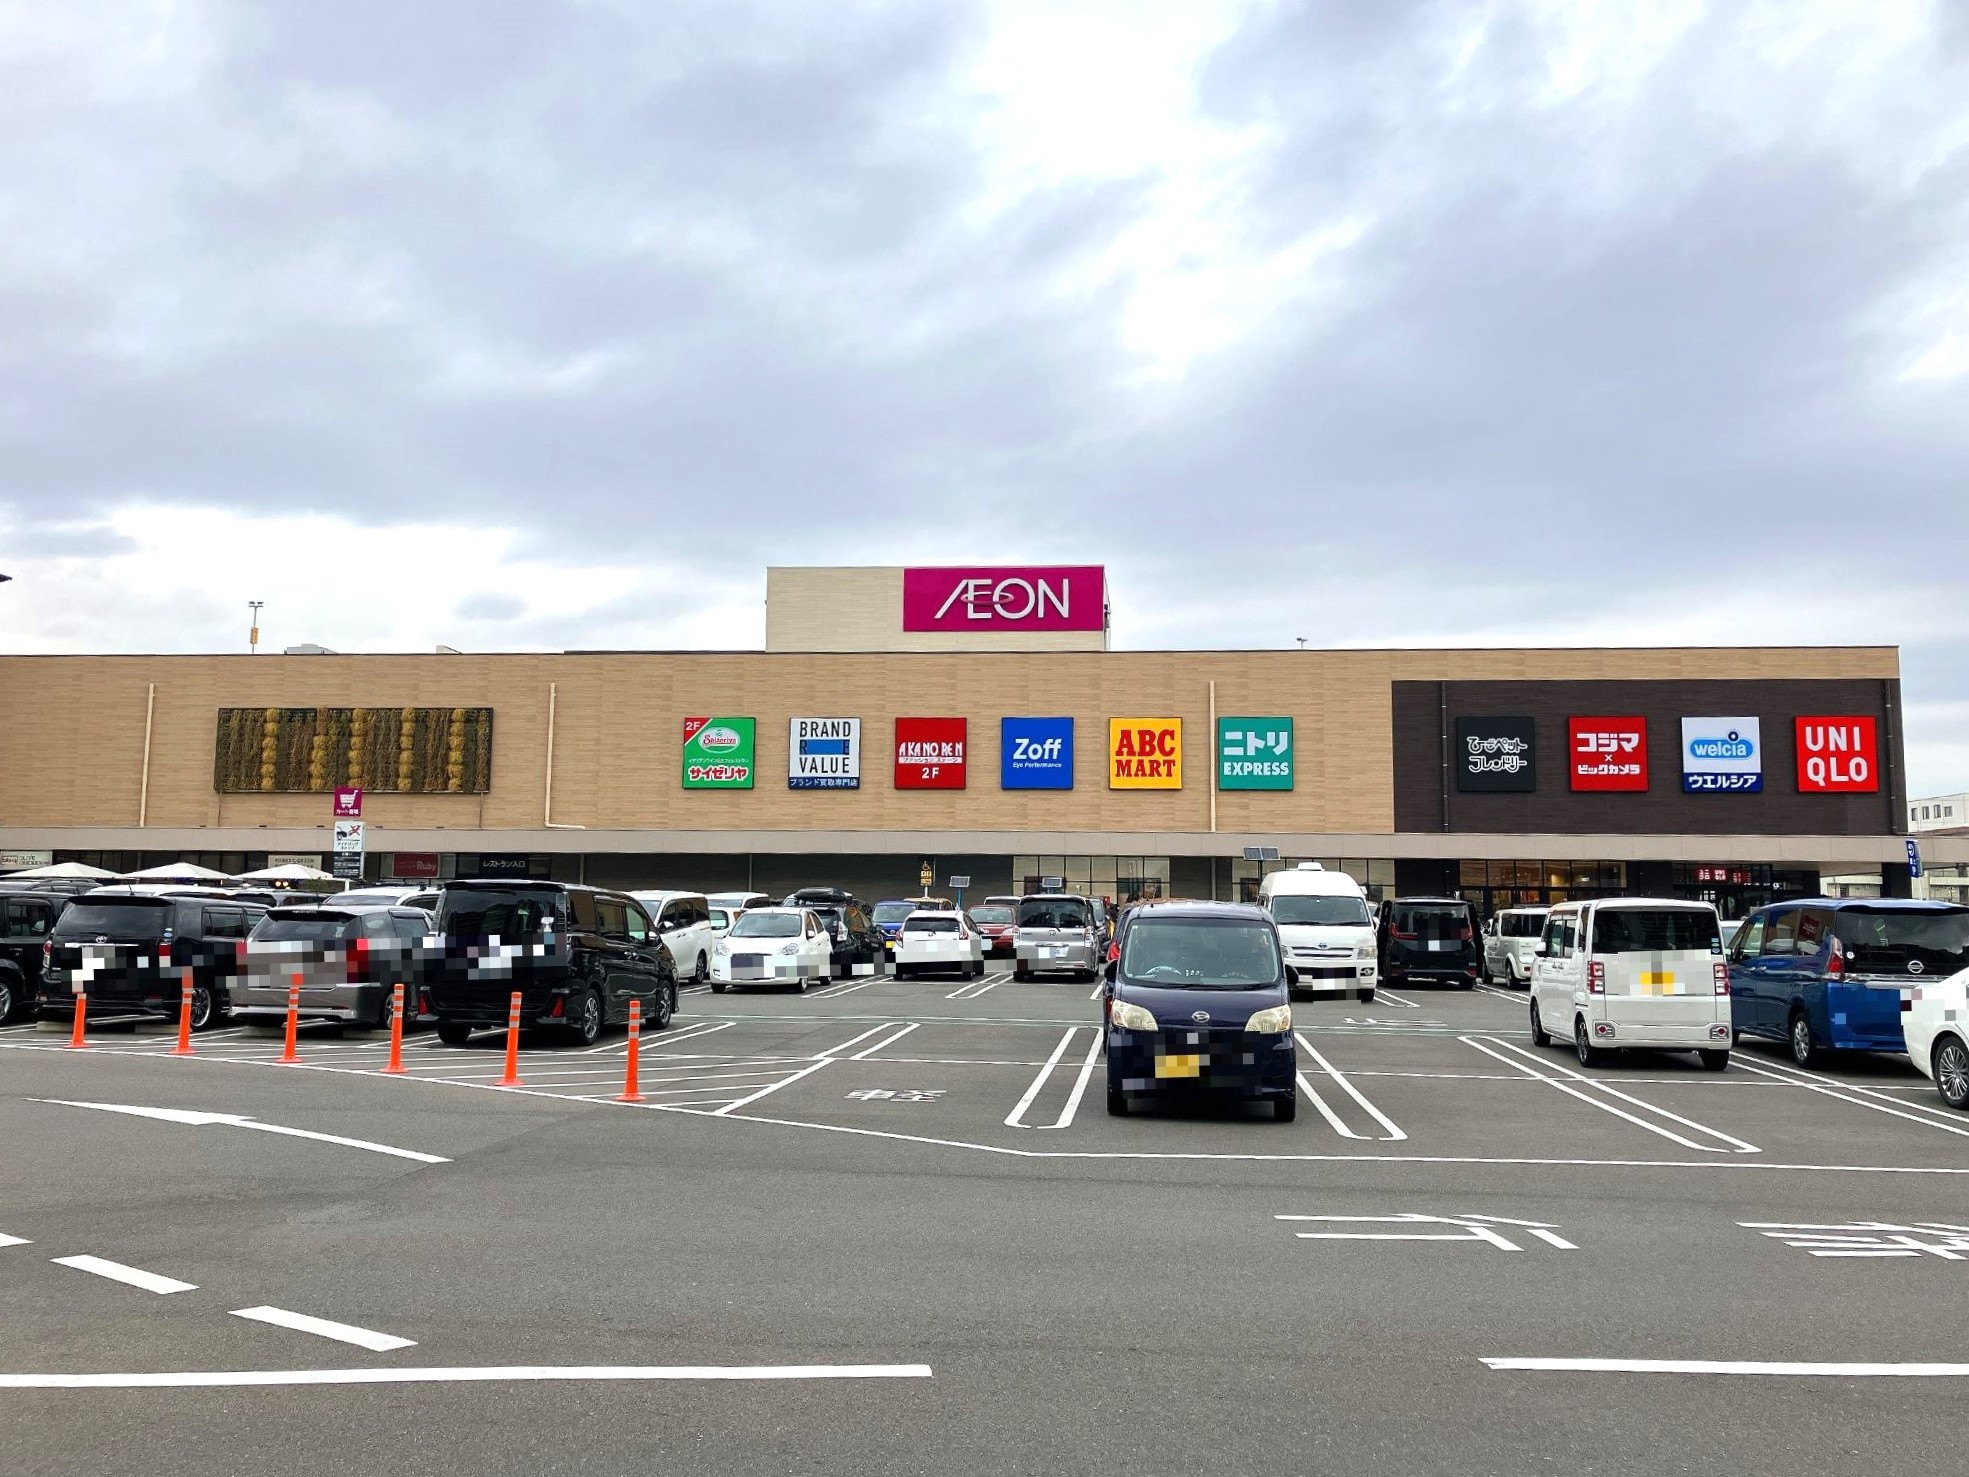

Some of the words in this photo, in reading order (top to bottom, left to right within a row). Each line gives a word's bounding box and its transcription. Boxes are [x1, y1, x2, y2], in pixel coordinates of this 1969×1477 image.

[685, 722, 701, 731] 2F
[800, 721, 852, 737] BRAND
[1116, 729, 1175, 757] ABC
[1223, 731, 1289, 756] ニトリ
[1577, 732, 1640, 752] コジマ
[1693, 735, 1747, 758] welcia
[1805, 726, 1861, 752] UNI
[1013, 738, 1062, 760] Zoff
[688, 765, 748, 781] サイゼリヤ
[799, 757, 850, 774] VALUE
[921, 767, 940, 779] 2F
[1115, 759, 1176, 778] MART
[1223, 762, 1290, 776] EXPRESS
[1577, 764, 1640, 775] ビックカメラ
[1807, 757, 1869, 786] QLO
[789, 778, 858, 788] ブランド買取専門店
[1688, 774, 1757, 789] ウエルシア
[416, 860, 437, 872] Ruby
[483, 860, 526, 868] レストラン入口
